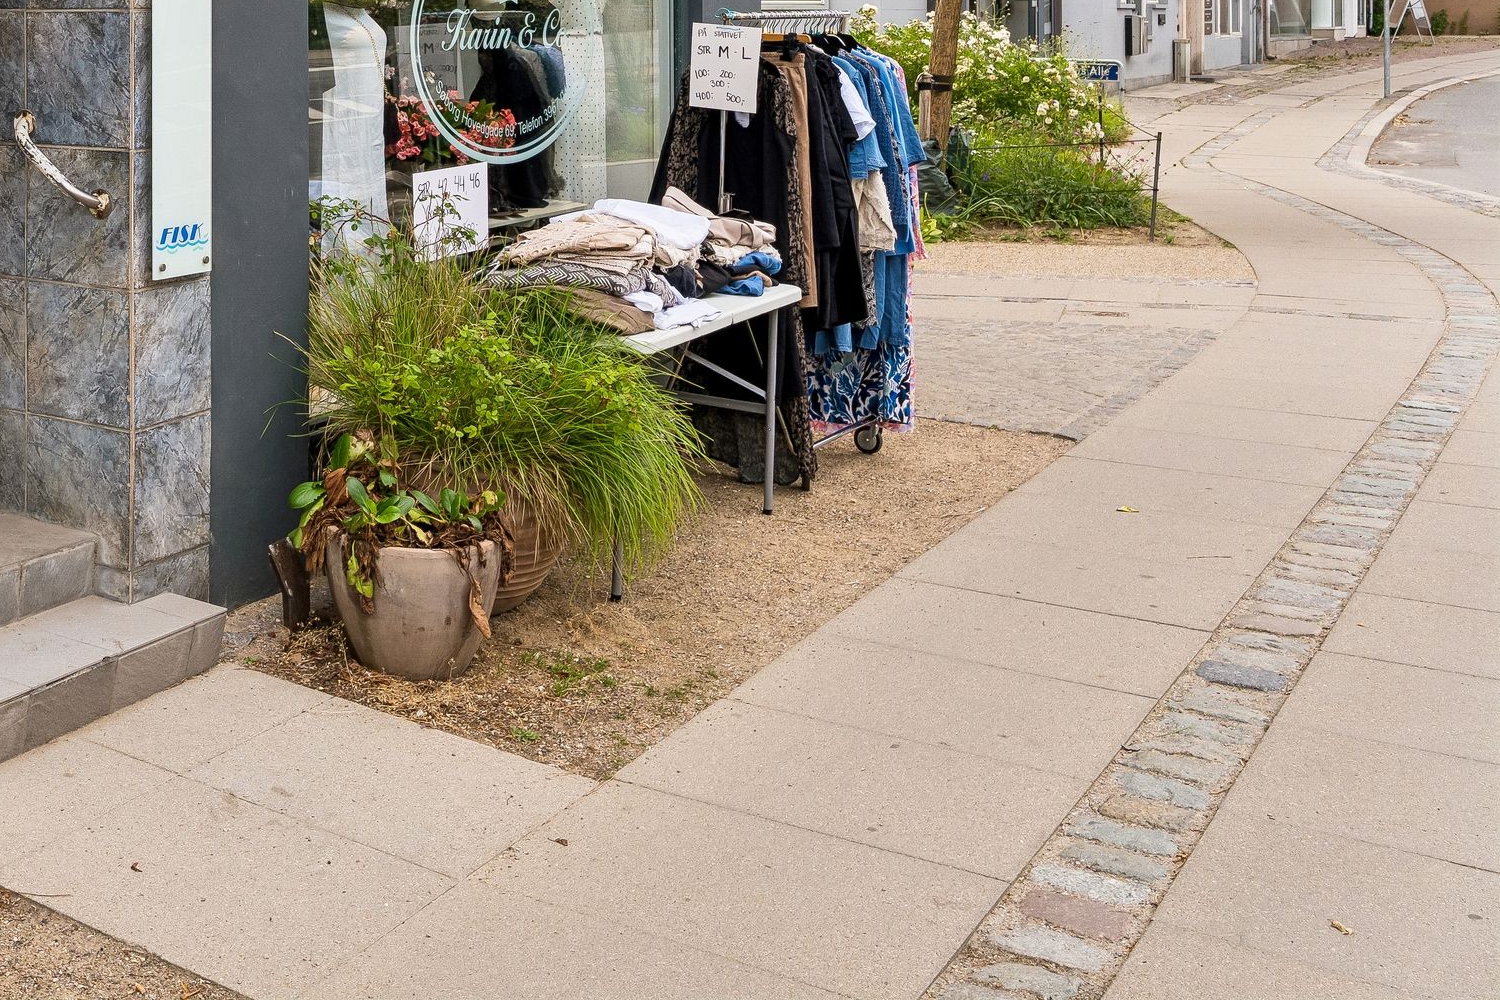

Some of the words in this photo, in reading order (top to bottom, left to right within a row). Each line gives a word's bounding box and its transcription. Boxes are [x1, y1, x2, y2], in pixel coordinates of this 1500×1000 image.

[441, 8, 513, 51] Karin
[518, 12, 537, 49] &
[697, 45, 711, 55] STR
[718, 45, 730, 59] M
[742, 47, 752, 60] L
[435, 80, 460, 121] Søborg
[461, 111, 503, 139] Hovedgade
[518, 115, 544, 136] Telefon
[454, 175, 465, 192] 44
[469, 172, 481, 189] 46
[160, 223, 203, 244] FISK
